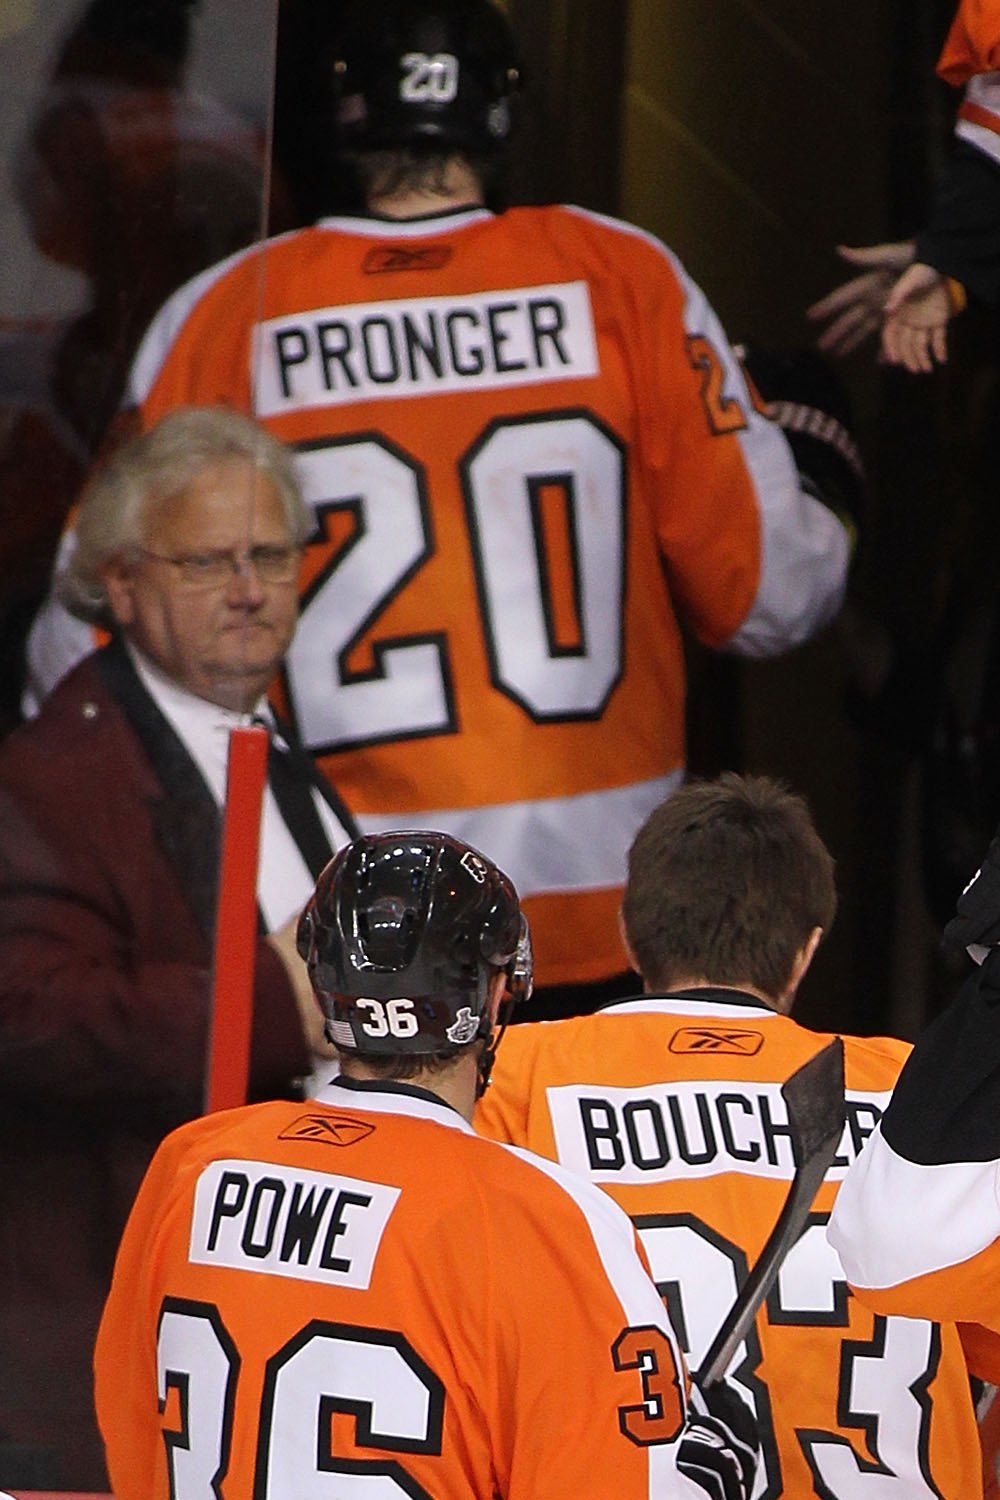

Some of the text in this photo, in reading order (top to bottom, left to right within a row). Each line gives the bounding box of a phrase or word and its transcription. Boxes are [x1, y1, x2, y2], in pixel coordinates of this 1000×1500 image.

[401, 52, 458, 102] 20
[274, 298, 572, 398] PRONGER
[281, 407, 628, 756] 20
[356, 998, 419, 1038] 36
[207, 1170, 373, 1274] POWE
